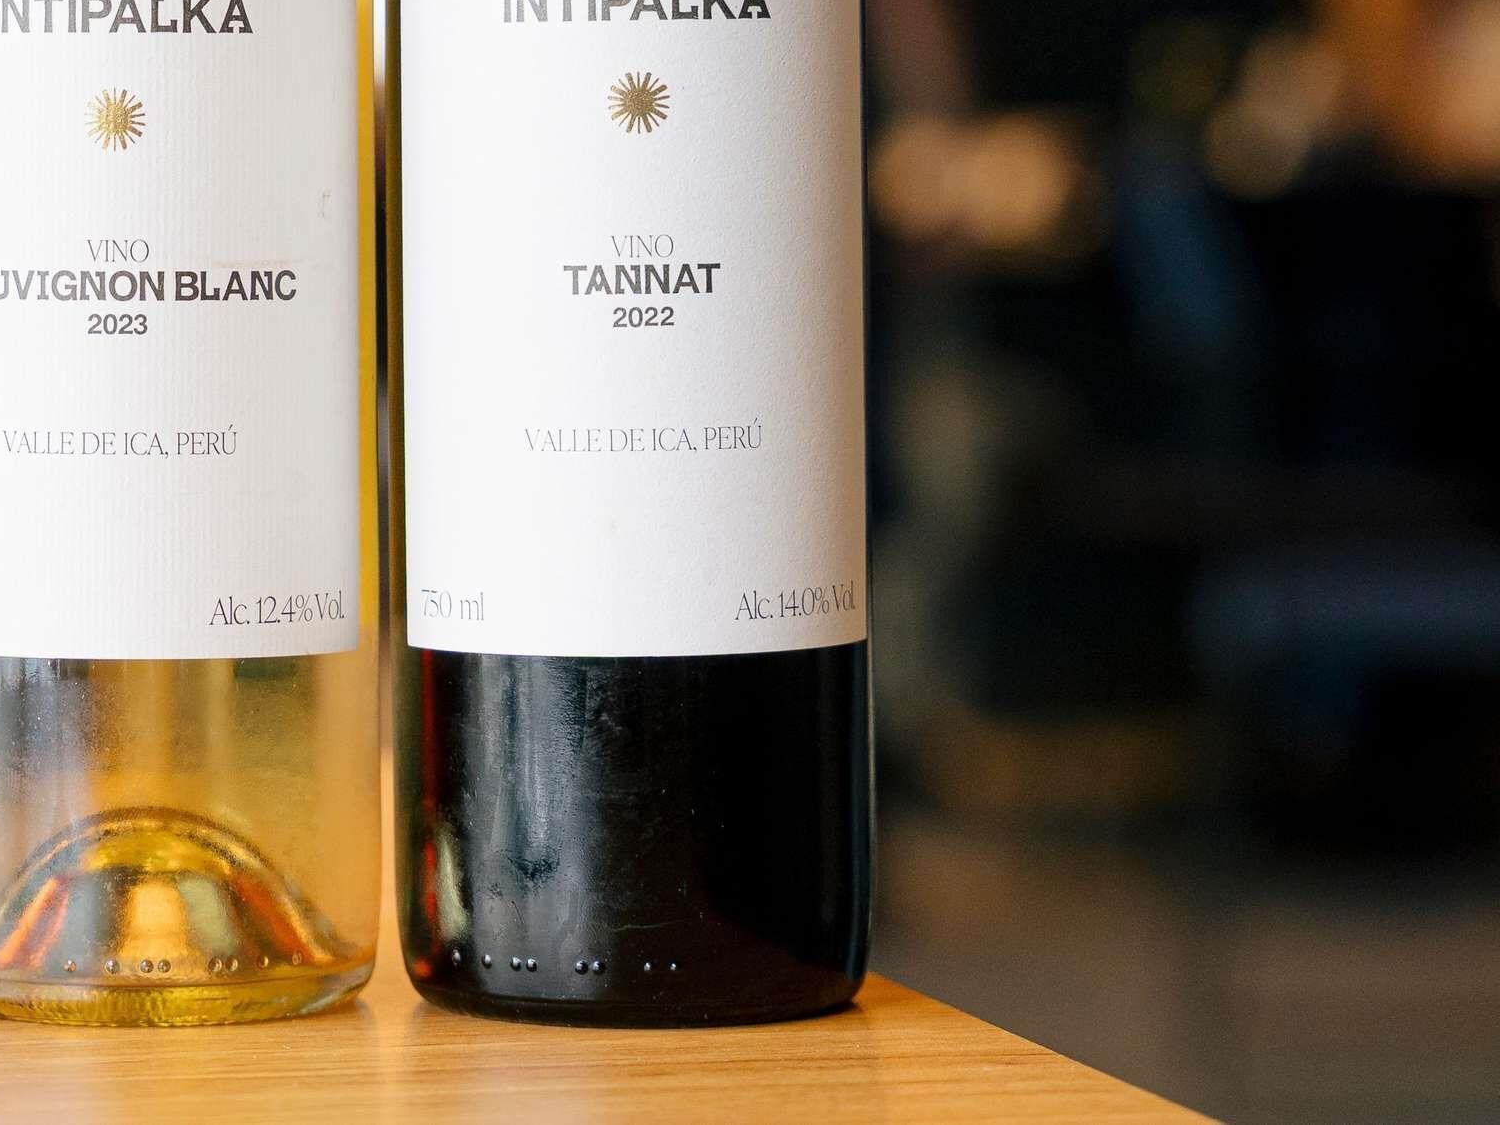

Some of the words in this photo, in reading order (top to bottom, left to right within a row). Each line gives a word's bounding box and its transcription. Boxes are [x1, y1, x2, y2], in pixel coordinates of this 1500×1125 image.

[87, 239, 150, 263] VINO
[611, 234, 674, 259] VINO
[174, 270, 298, 301] BLANC
[563, 263, 721, 296] TANNAT
[87, 313, 148, 335] 2023
[612, 306, 675, 328] 2022
[2, 430, 75, 455] VALLE
[80, 431, 117, 456] DE
[123, 431, 170, 459] ICA,
[176, 424, 238, 456] PERÚ
[524, 428, 602, 452] VALLE
[608, 428, 646, 452] DE
[651, 426, 697, 454] ICA,
[703, 417, 763, 450] PERÚ
[208, 595, 251, 626] Alc.
[256, 596, 314, 625] 12.4%
[420, 589, 453, 618] 750
[459, 591, 485, 621] ml
[734, 590, 774, 621] Alc.
[778, 587, 830, 618] 14.0%
